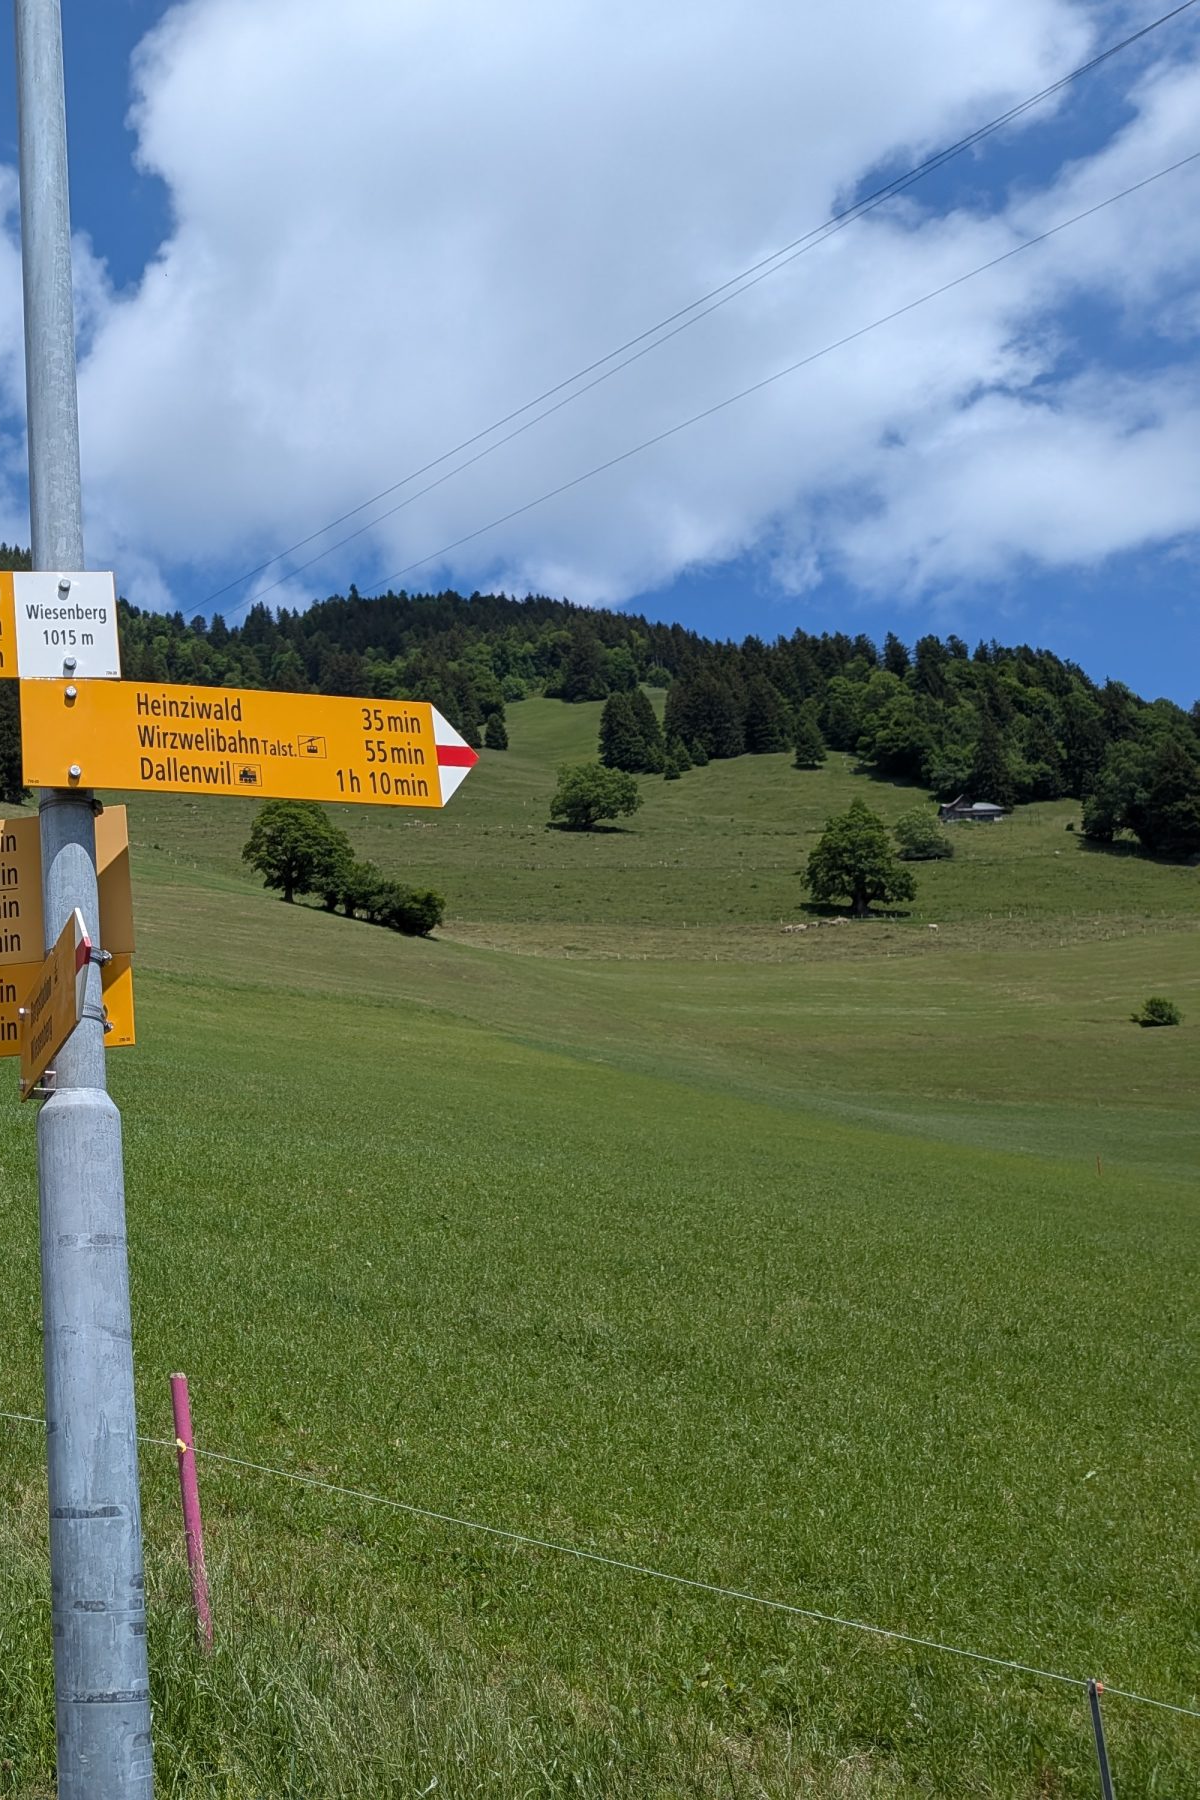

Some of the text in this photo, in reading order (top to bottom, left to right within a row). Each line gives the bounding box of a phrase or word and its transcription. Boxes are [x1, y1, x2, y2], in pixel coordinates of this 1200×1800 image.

[26, 604, 107, 624] Wiesenberg
[43, 629, 94, 646] 1015 m
[136, 692, 242, 722] Heinziwald
[137, 724, 260, 755] Wirzwelibahn
[261, 739, 297, 757] Talst.
[140, 756, 231, 785] Dallenwil
